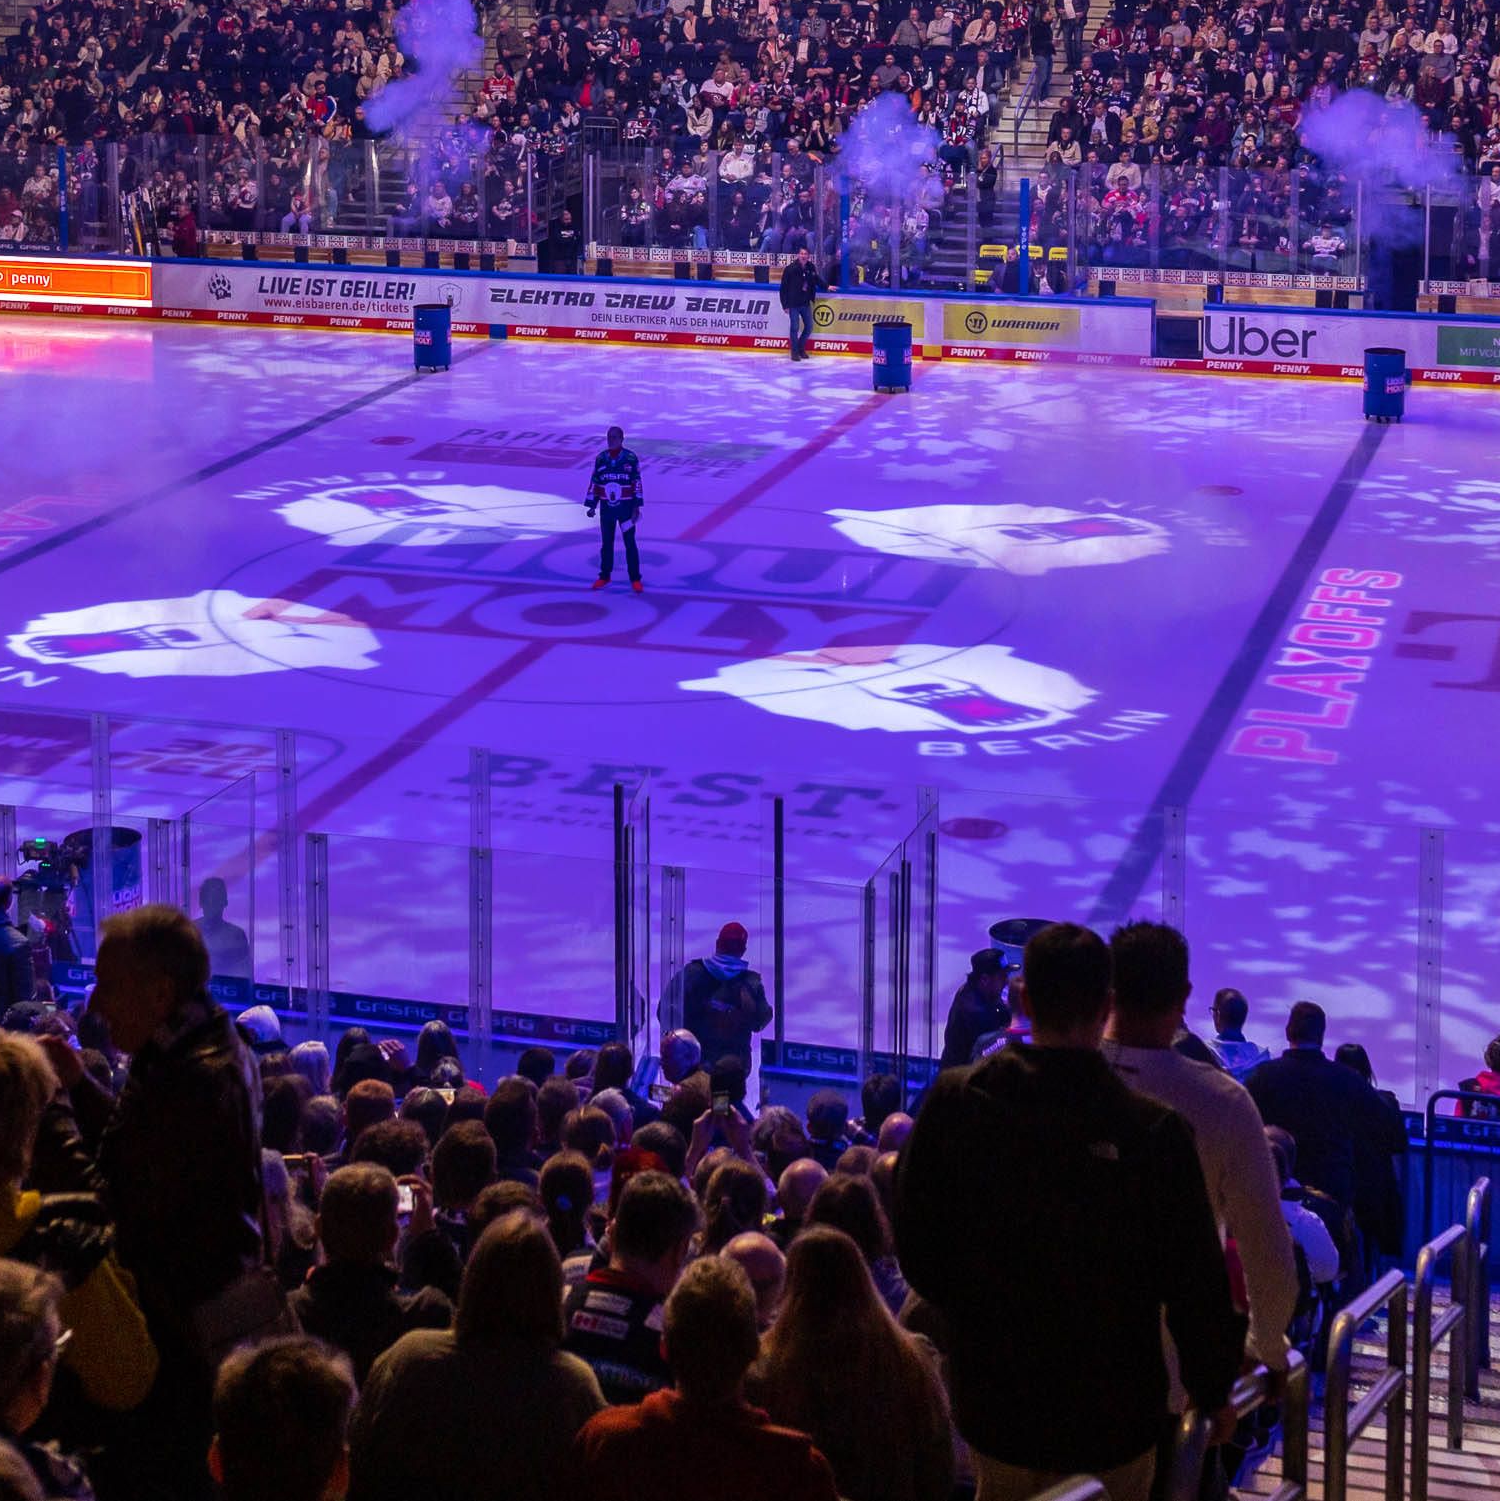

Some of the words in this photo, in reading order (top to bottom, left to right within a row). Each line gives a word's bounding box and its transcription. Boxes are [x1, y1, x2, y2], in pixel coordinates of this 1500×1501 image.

[11, 272, 50, 288] penny
[258, 275, 302, 295] LIVE
[304, 278, 338, 297] IST
[340, 280, 417, 301] GEILER!
[263, 297, 410, 314] www.eisbaeren.de/tickets
[489, 287, 595, 306] ELEKTRO
[604, 292, 676, 310] CREW
[684, 296, 771, 315] BERLIN
[591, 312, 612, 323] DEIN
[614, 314, 667, 326] ELEKTRIKER
[669, 316, 688, 327] AUS
[689, 317, 708, 328] DER
[710, 318, 769, 330] HAUPTSTADT
[838, 313, 906, 323] WARRIOR
[990, 319, 1060, 331] WARRIOR
[1205, 315, 1316, 358] Uber
[1459, 348, 1476, 358] MIT
[350, 532, 922, 602] LIQUI
[312, 572, 920, 654] MOLY
[1227, 567, 1404, 765] PLAYOFFS
[916, 709, 1172, 757] BERLIN
[354, 997, 437, 1021] GASAG
